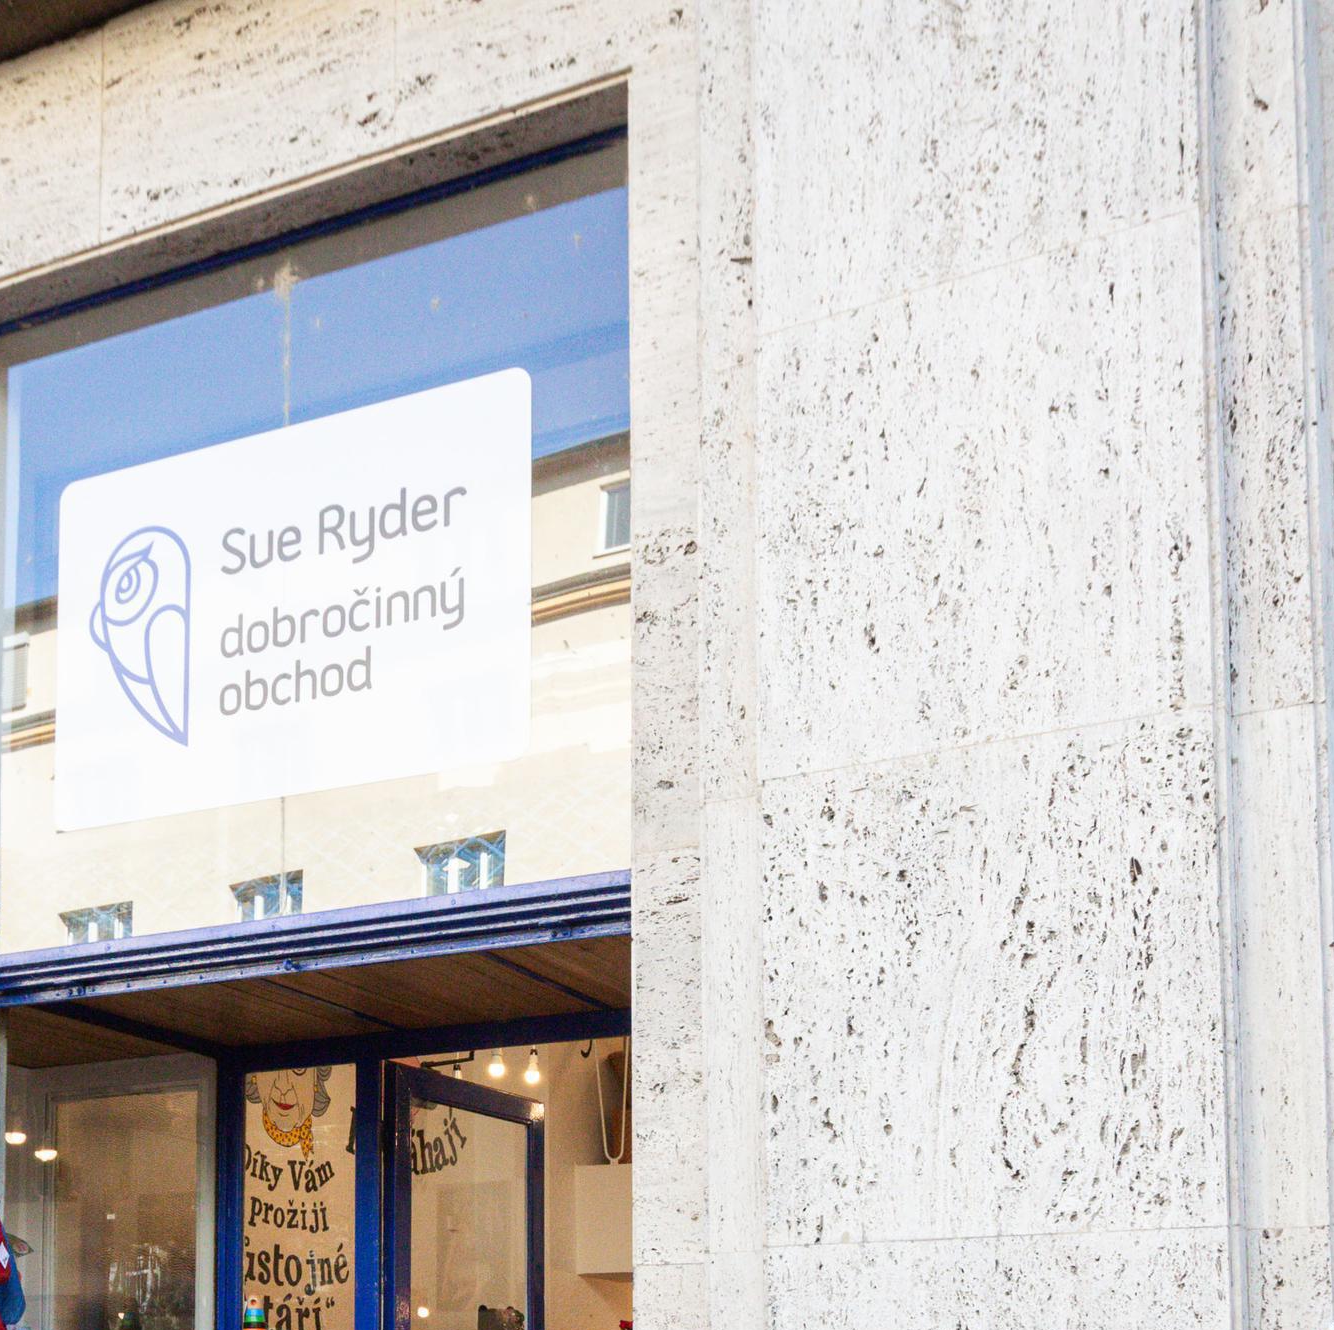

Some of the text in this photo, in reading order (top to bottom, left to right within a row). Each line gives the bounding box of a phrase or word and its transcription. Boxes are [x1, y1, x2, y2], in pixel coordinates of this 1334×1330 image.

[221, 485, 468, 576] Sue Ryder
[220, 566, 466, 659] dobročinný
[219, 645, 373, 716] obchod
[287, 1159, 336, 1194] Vám
[247, 1196, 330, 1234] prožiji
